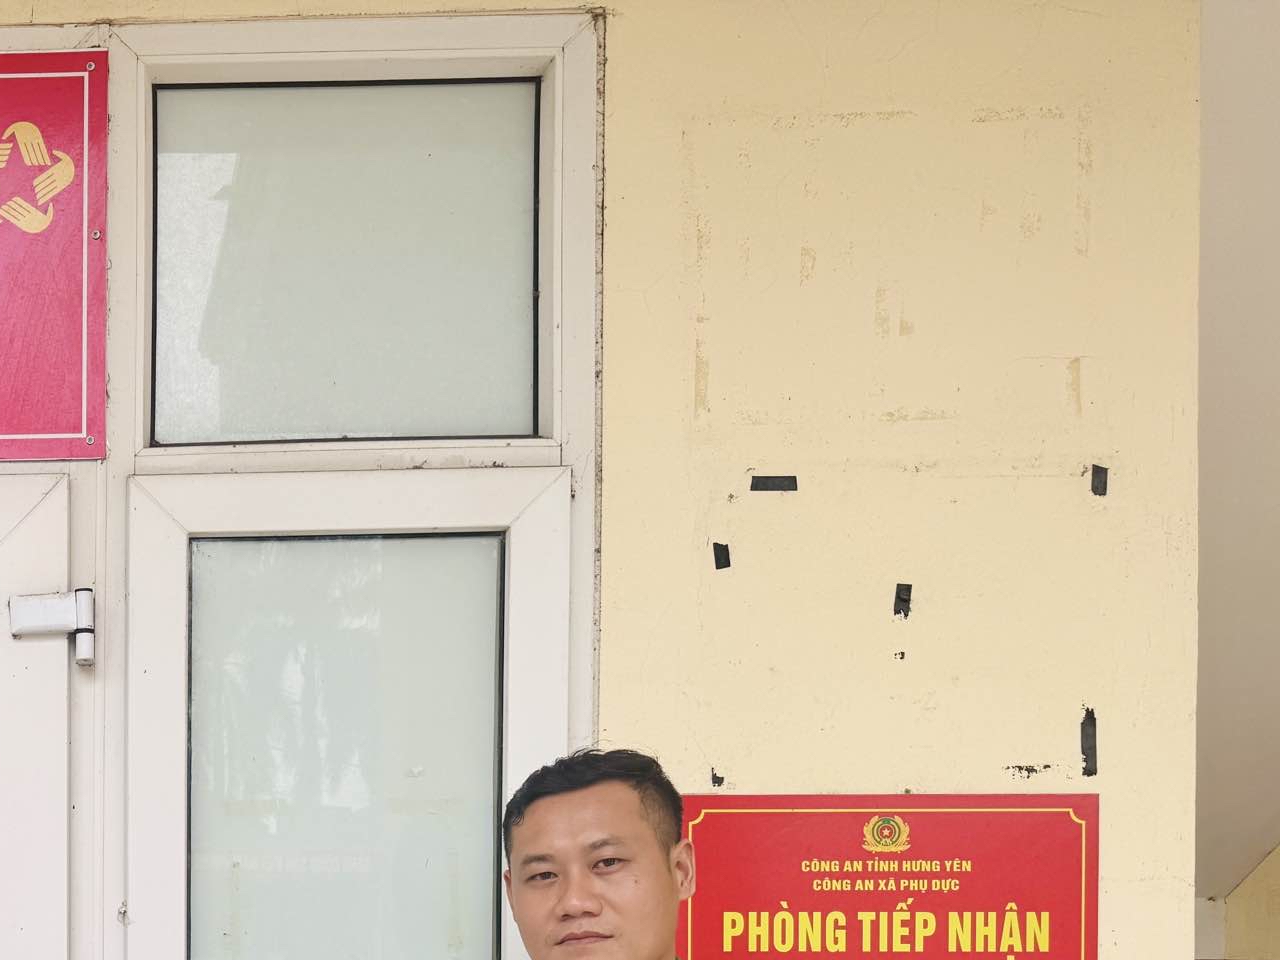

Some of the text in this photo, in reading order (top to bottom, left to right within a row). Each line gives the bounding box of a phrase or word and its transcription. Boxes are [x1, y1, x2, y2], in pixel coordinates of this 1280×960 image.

[801, 857, 972, 873] CÔNG AN TỈNH HƯNG YÊN
[812, 877, 960, 894] CÔNG AN XÃ PHỤ DỰC
[722, 901, 847, 953] PHÒNG
[858, 898, 936, 953] TIẾP
